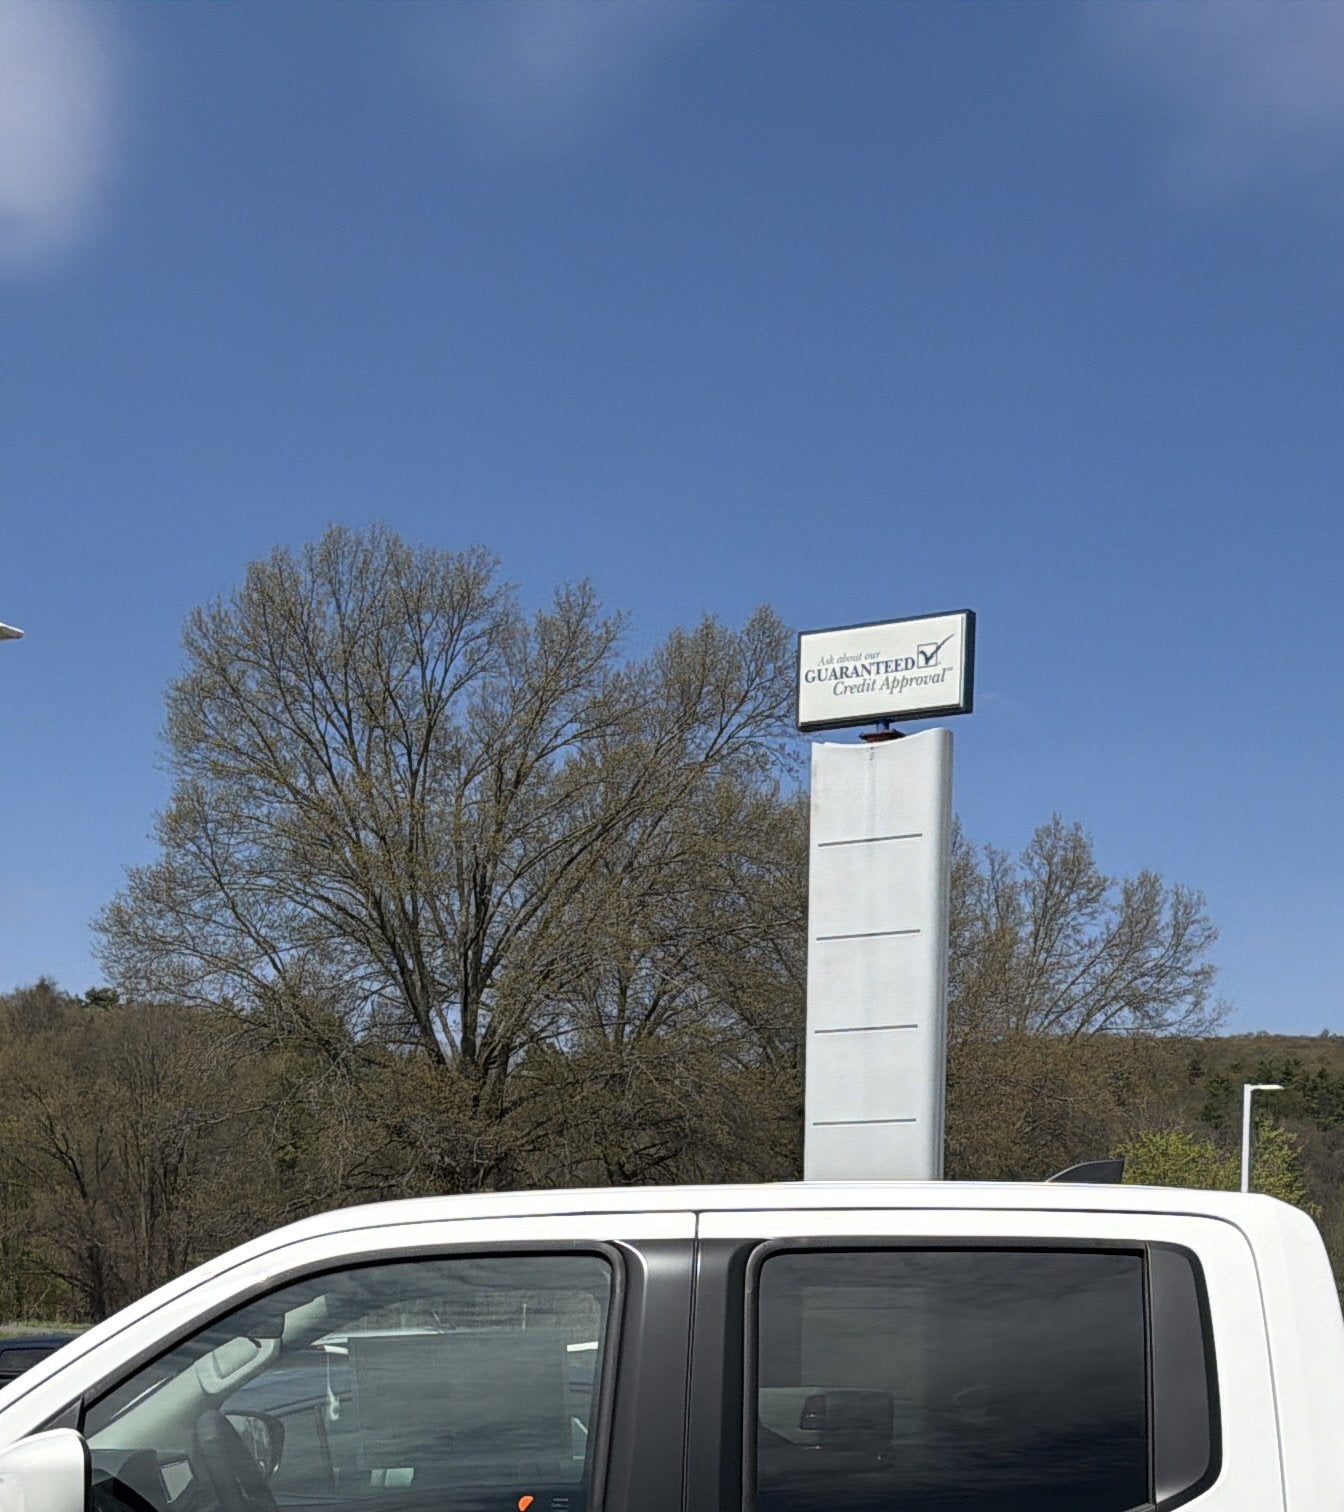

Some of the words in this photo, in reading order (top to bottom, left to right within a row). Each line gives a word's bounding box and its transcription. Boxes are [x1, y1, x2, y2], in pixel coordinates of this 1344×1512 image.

[804, 656, 916, 684] GUARANTEED
[817, 653, 835, 667] Ask
[836, 651, 862, 665] about
[865, 650, 881, 661] our
[832, 677, 876, 697] Credit
[879, 667, 948, 695] Approval
